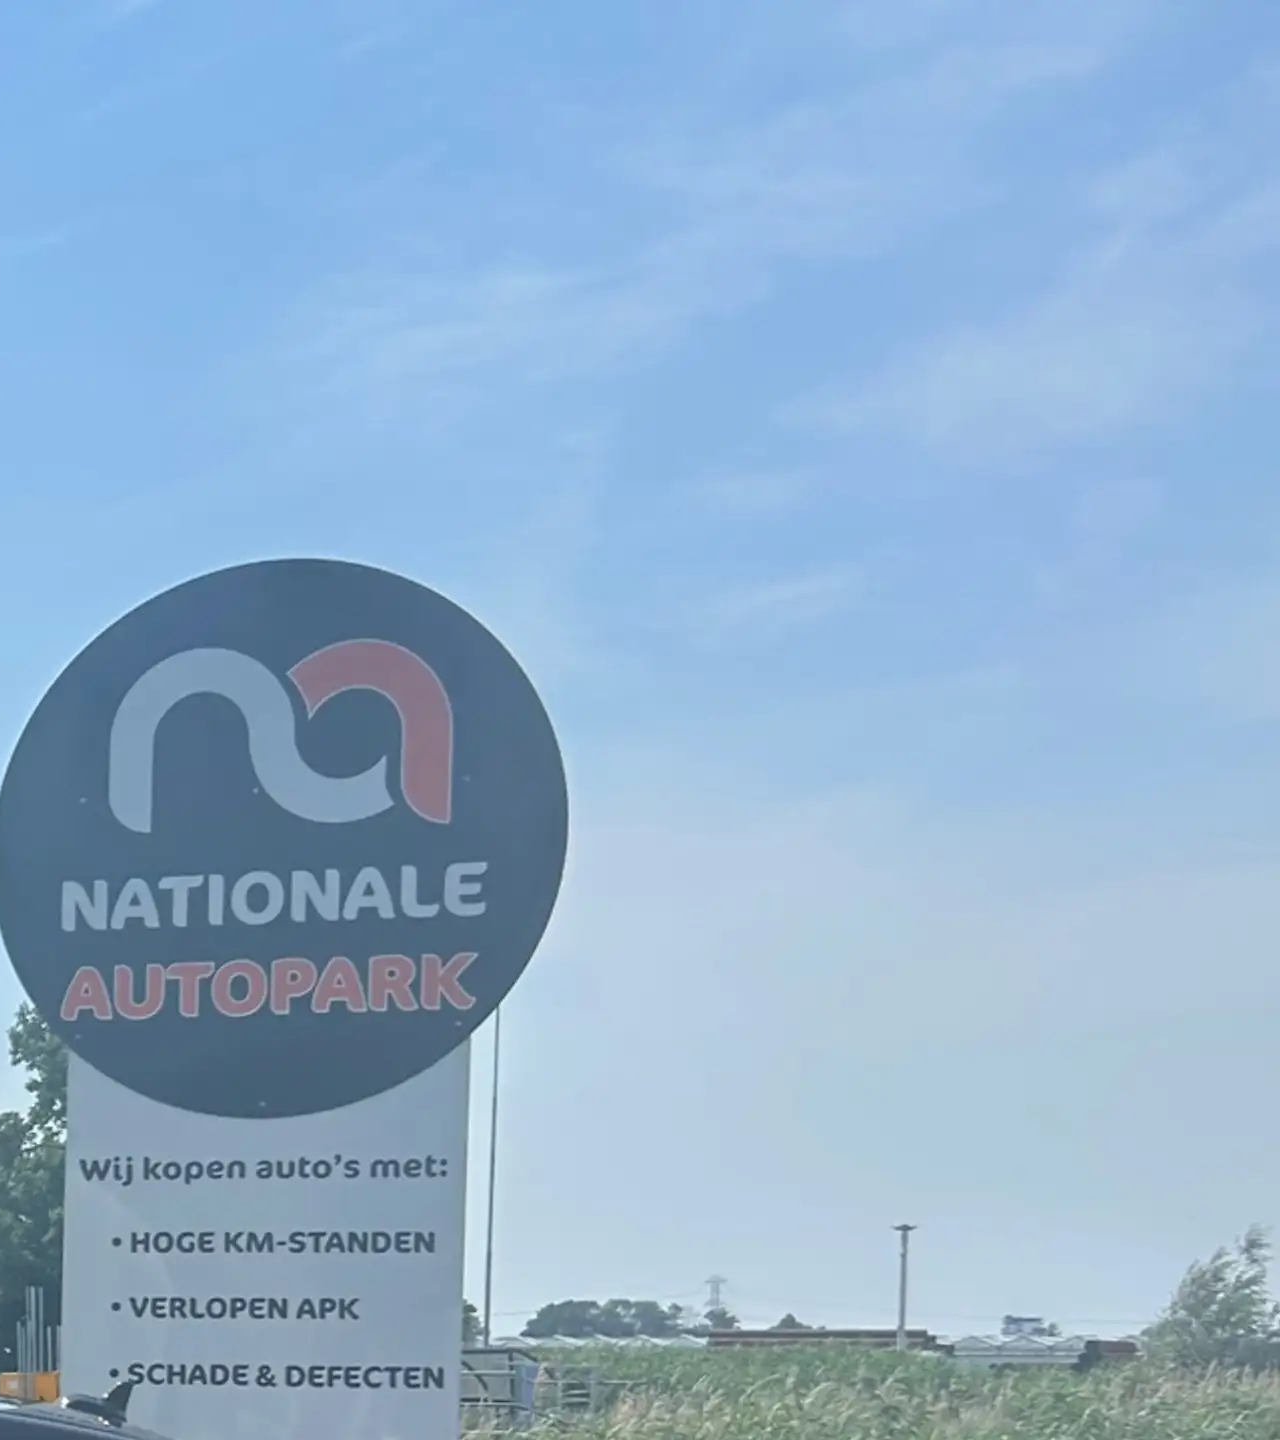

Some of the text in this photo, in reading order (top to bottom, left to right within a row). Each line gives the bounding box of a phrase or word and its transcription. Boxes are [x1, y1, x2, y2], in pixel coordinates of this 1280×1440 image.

[60, 861, 488, 932] NATIONALE
[60, 951, 479, 1022] AUTOPARK
[79, 1154, 449, 1186] Wij kopen auto's met:
[129, 1231, 436, 1255] HOGE KM-STANDEN
[128, 1297, 360, 1321] VERLOPEN APK
[126, 1362, 445, 1390] SCHADE & DEFECTEN
